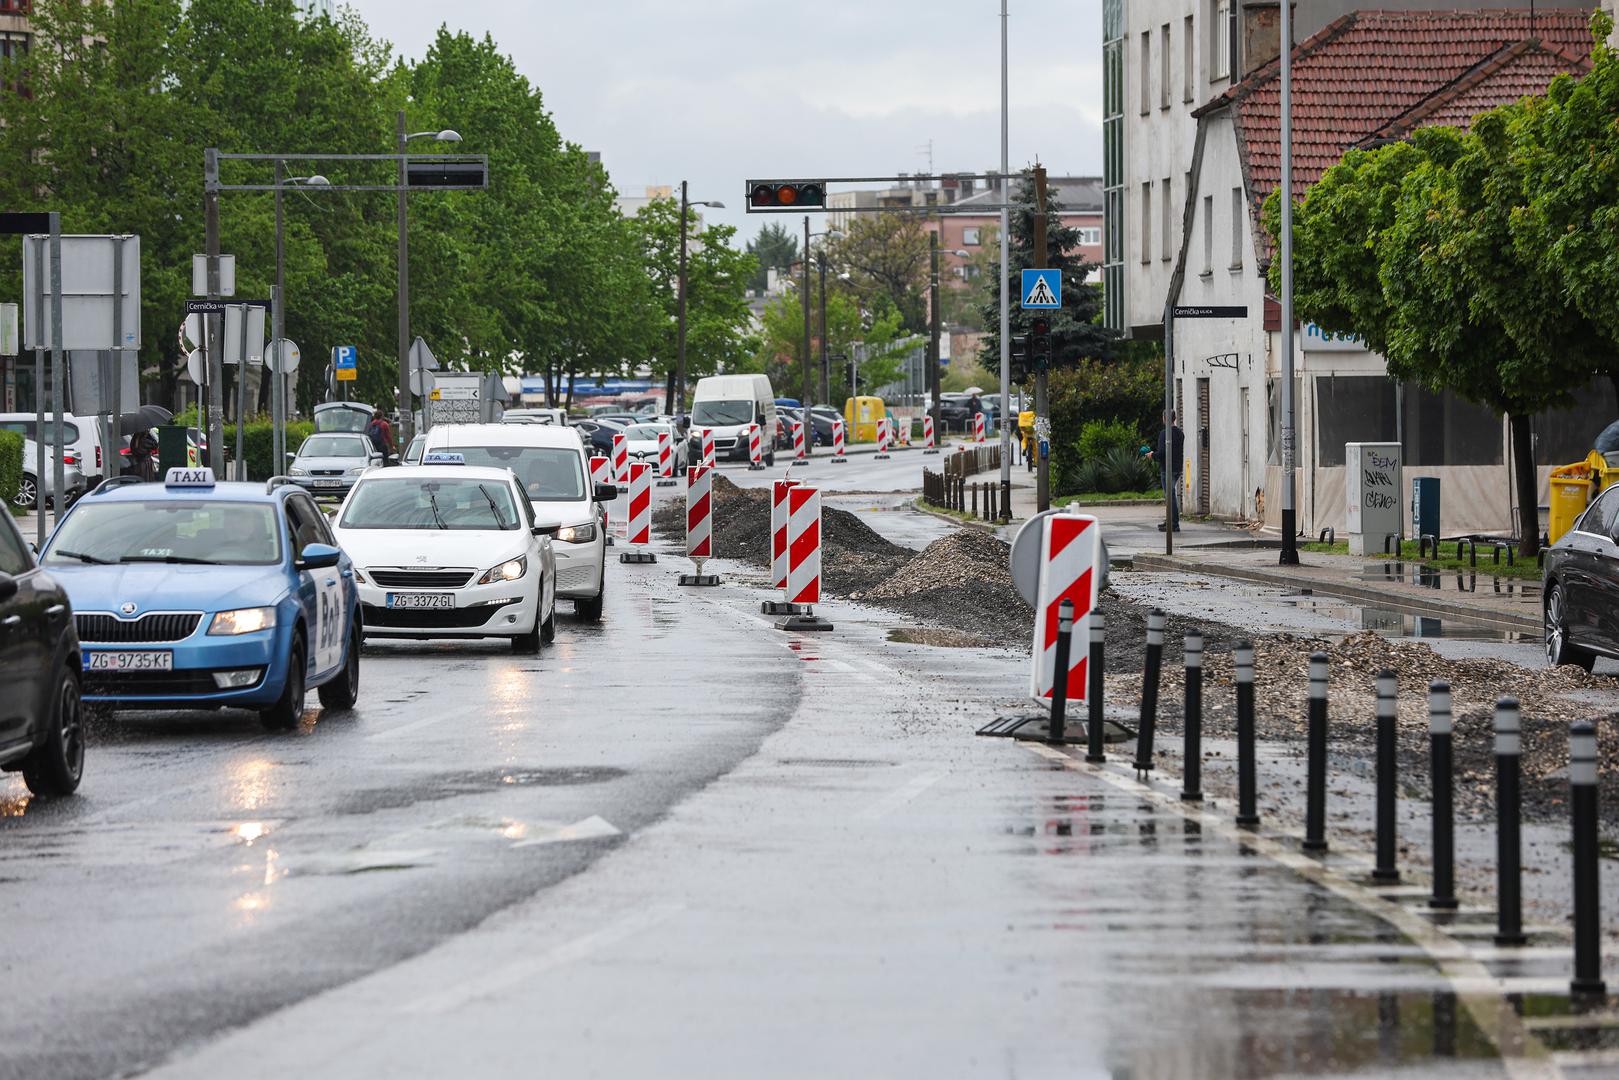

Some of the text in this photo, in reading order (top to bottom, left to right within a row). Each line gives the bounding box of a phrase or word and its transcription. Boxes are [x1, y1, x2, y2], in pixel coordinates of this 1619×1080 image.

[189, 302, 217, 310] Cernička
[338, 346, 350, 364] P
[173, 470, 207, 483] TAXI
[143, 548, 171, 556] TAXI
[394, 595, 407, 607] ZG
[91, 653, 108, 668] ZG
